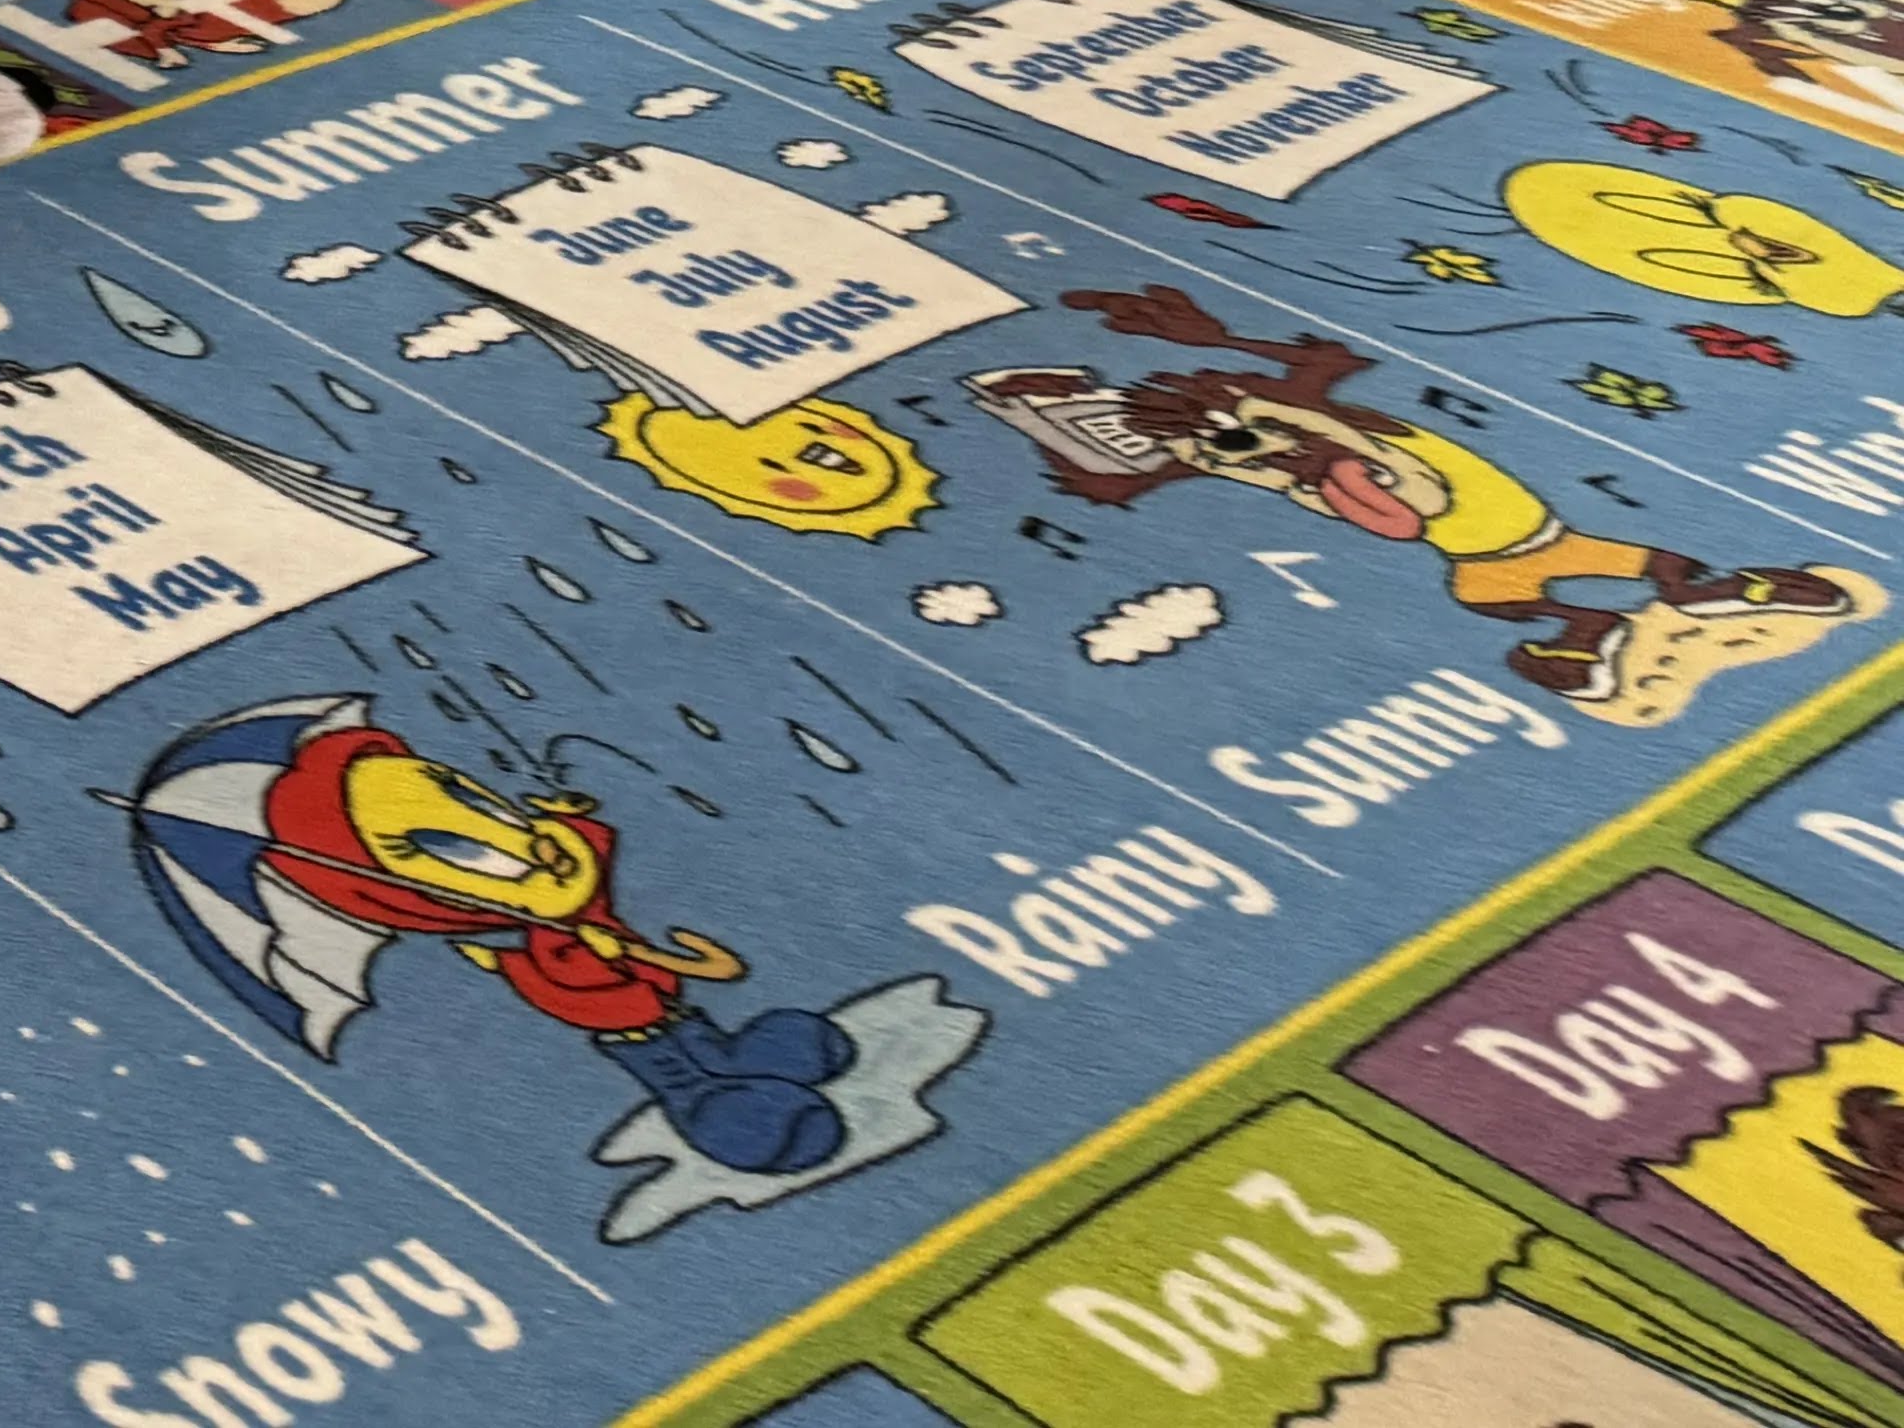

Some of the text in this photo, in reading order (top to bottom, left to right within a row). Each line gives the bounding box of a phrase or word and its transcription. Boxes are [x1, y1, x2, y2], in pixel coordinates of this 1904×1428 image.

[117, 55, 588, 224] Summer
[1090, 38, 1291, 121] October
[1163, 70, 1411, 167] November
[529, 201, 694, 269] June
[628, 248, 794, 312] July
[695, 278, 919, 372] August
[74, 553, 266, 635] May
[1207, 666, 1571, 829] Sunny
[903, 825, 1280, 999] Rainy
[1457, 930, 1785, 1124] Day 4
[75, 1237, 522, 1428] Snowy
[1043, 1168, 1403, 1397] Day 3
